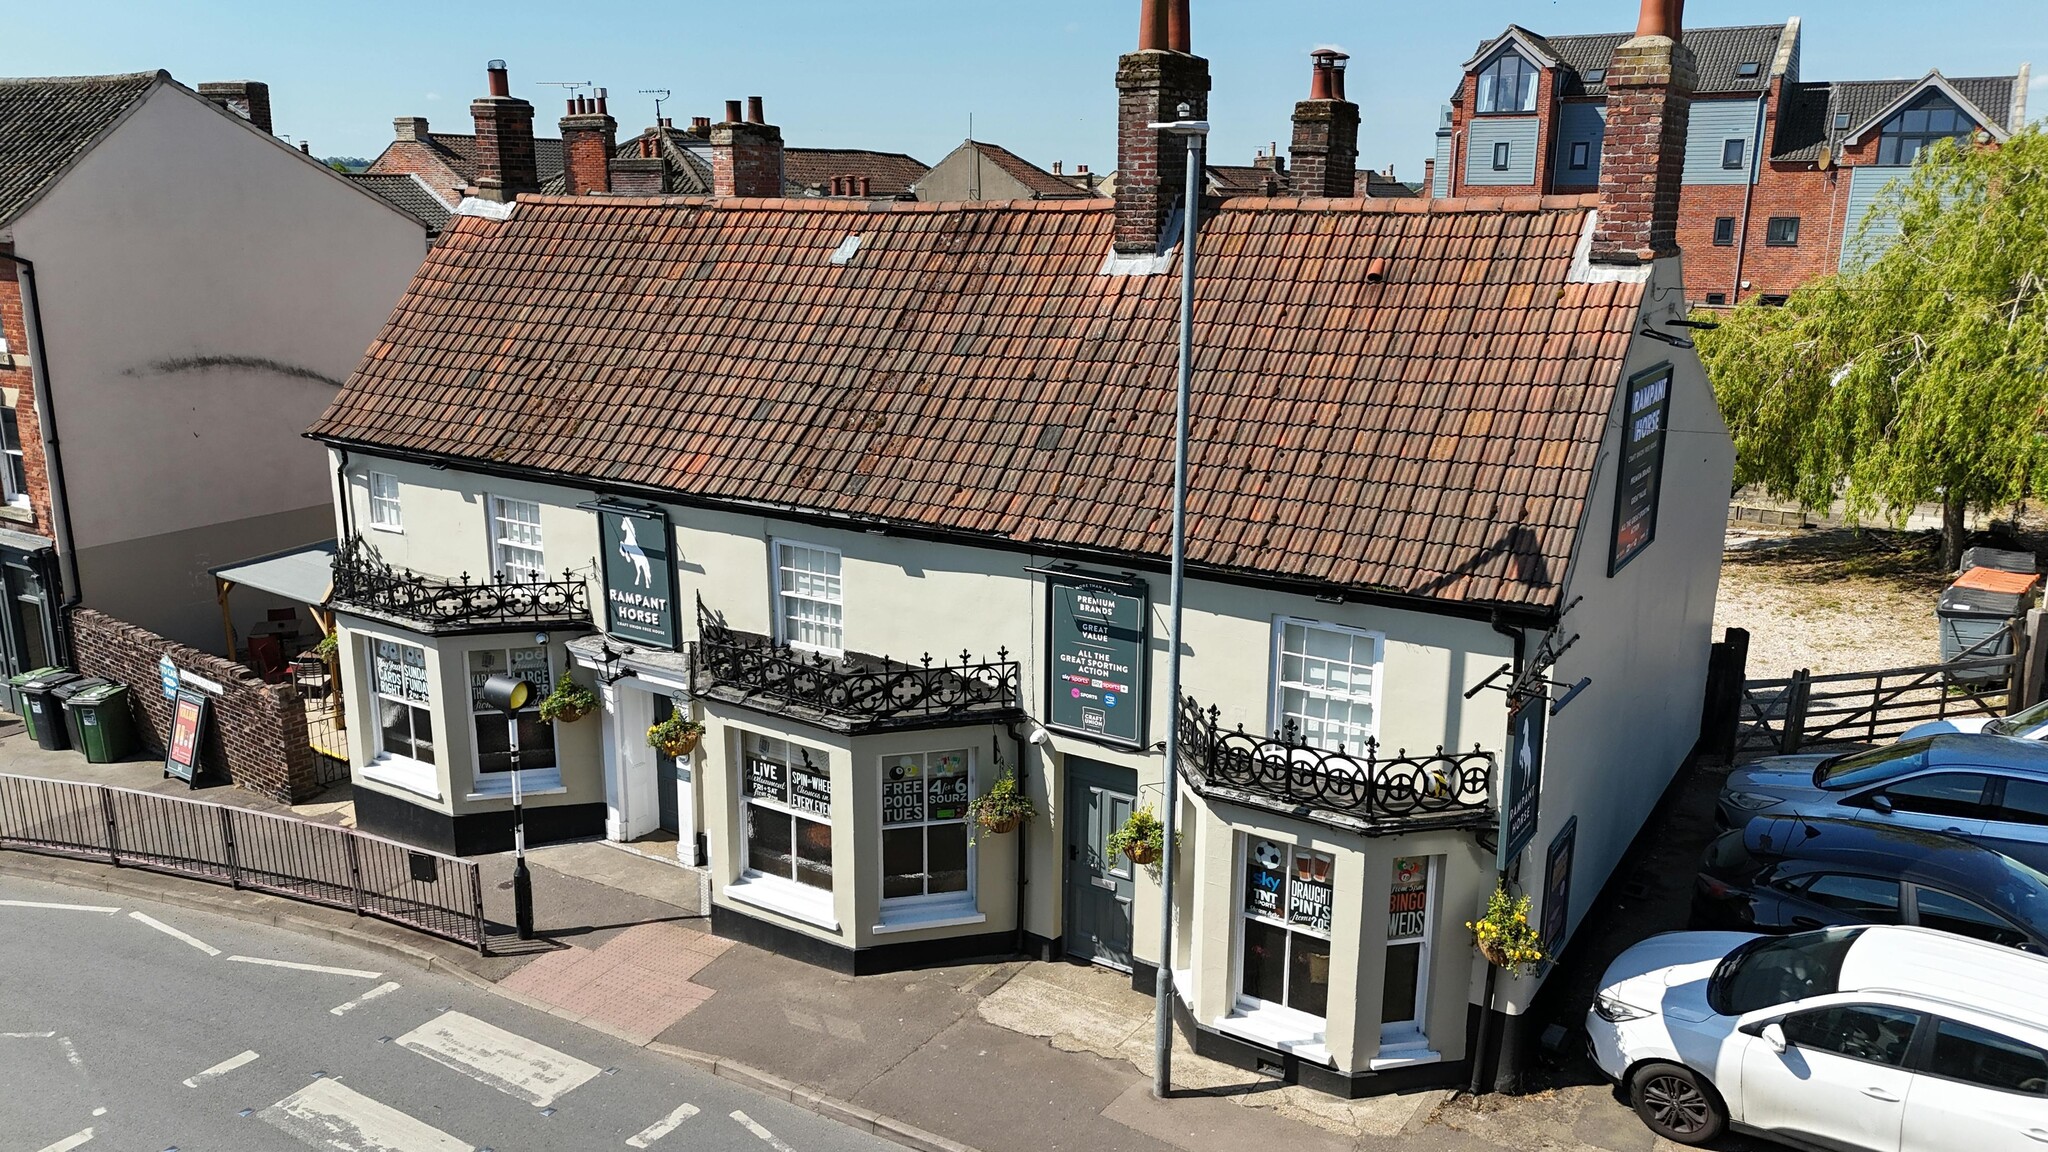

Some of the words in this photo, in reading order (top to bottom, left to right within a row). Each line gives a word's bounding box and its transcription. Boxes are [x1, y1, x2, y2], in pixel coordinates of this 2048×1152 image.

[1631, 377, 1668, 414] RAMPANT
[1633, 409, 1660, 442] HORSE
[609, 588, 667, 611] RAMPANT
[1077, 595, 1116, 609] PREMIUM
[618, 606, 659, 625] HORSE
[1079, 603, 1113, 616] BRANDS
[1082, 623, 1109, 635] GREAT
[1082, 631, 1108, 642] VALUE
[515, 651, 544, 661] DOG
[1078, 650, 1093, 660] ALL
[1094, 652, 1110, 662] THE
[1060, 654, 1086, 666] GREAT
[1087, 659, 1129, 674] SPORTING
[1078, 665, 1110, 678] ACTION
[378, 669, 402, 686] CARDS
[380, 681, 401, 696] RIGHT
[1080, 692, 1098, 700] SPORTS
[1084, 713, 1103, 722] CRAFT
[1084, 718, 1103, 727] UNION
[883, 781, 922, 796] FREE
[929, 779, 942, 795] 4
[791, 794, 814, 811] EVERY
[883, 794, 922, 809] POOL
[929, 793, 967, 804] SOURZ
[1509, 784, 1536, 821] RAMPANT
[884, 806, 923, 822] TUES
[1511, 805, 1531, 835] HORSE
[1254, 871, 1280, 892] sky
[1253, 888, 1278, 903] TNT
[1291, 880, 1332, 905] DRAUGHT
[1254, 899, 1276, 910] SPORTS
[1290, 896, 1331, 920] PINTS
[1389, 892, 1426, 912] BINGO
[1388, 910, 1424, 937] WEDS
